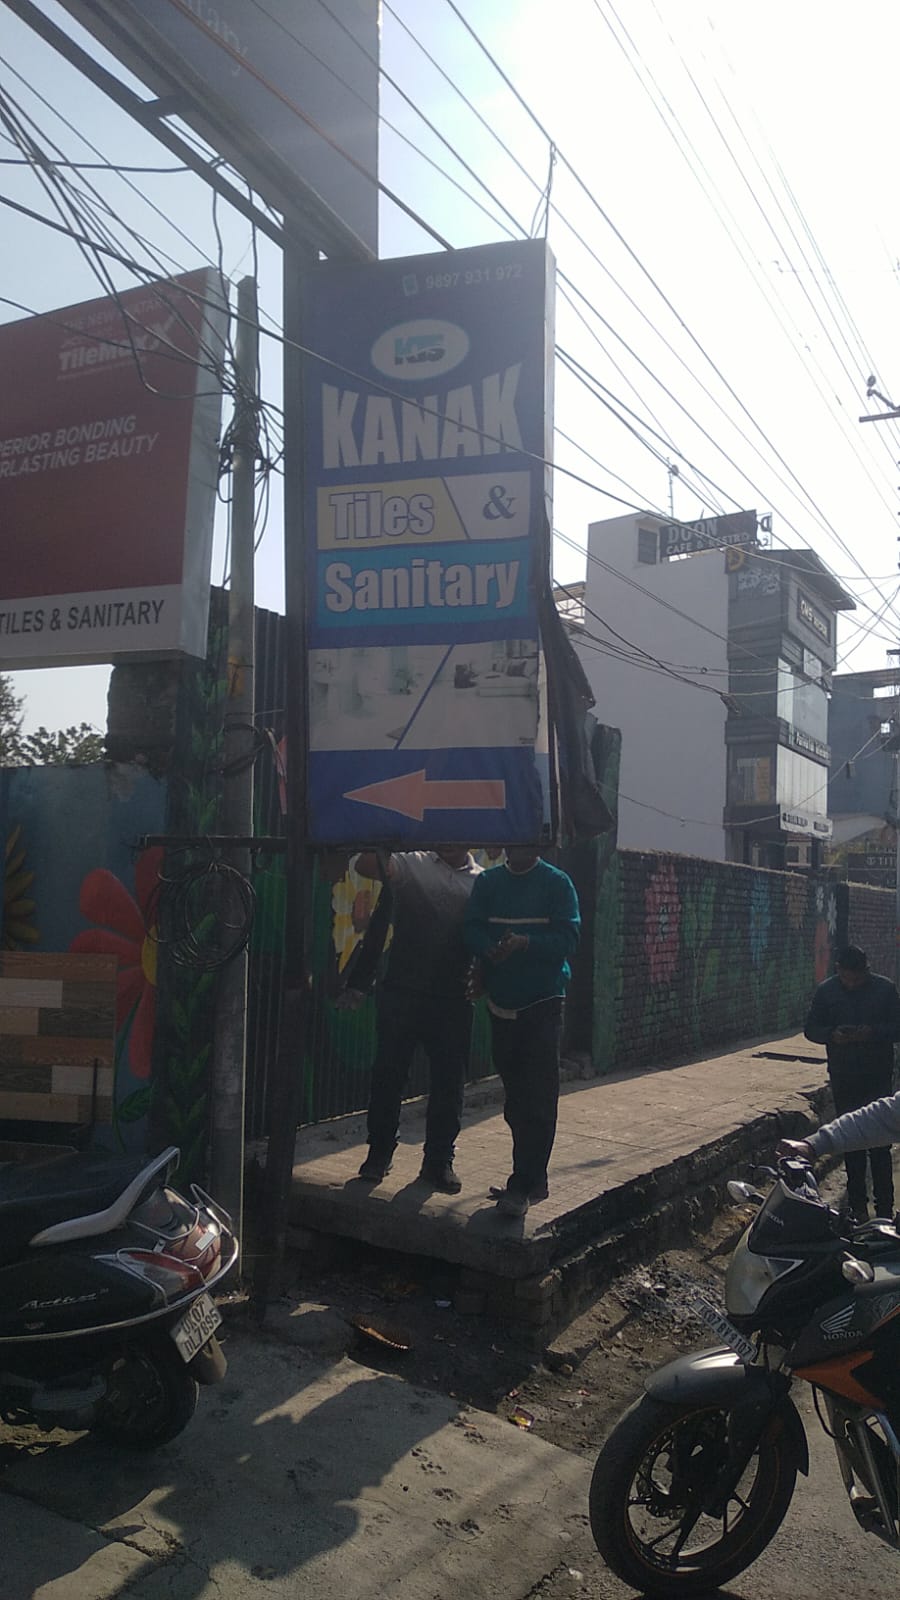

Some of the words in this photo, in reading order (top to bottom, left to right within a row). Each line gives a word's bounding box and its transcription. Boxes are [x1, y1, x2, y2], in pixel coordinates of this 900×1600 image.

[425, 272, 459, 290] 9897
[464, 267, 491, 285] 931
[495, 264, 523, 281] 972
[54, 414, 137, 448] BONDING
[321, 362, 526, 469] KANAK
[84, 430, 160, 463] BEAUTY
[328, 490, 435, 541] Tiles
[482, 484, 517, 521] &
[324, 558, 520, 614] Sanitary
[49, 607, 62, 632] &
[67, 599, 165, 631] SANITARY
[182, 1300, 205, 1335] UK07
[184, 1307, 219, 1356] DL7895
[823, 1329, 864, 1341] HONDA
